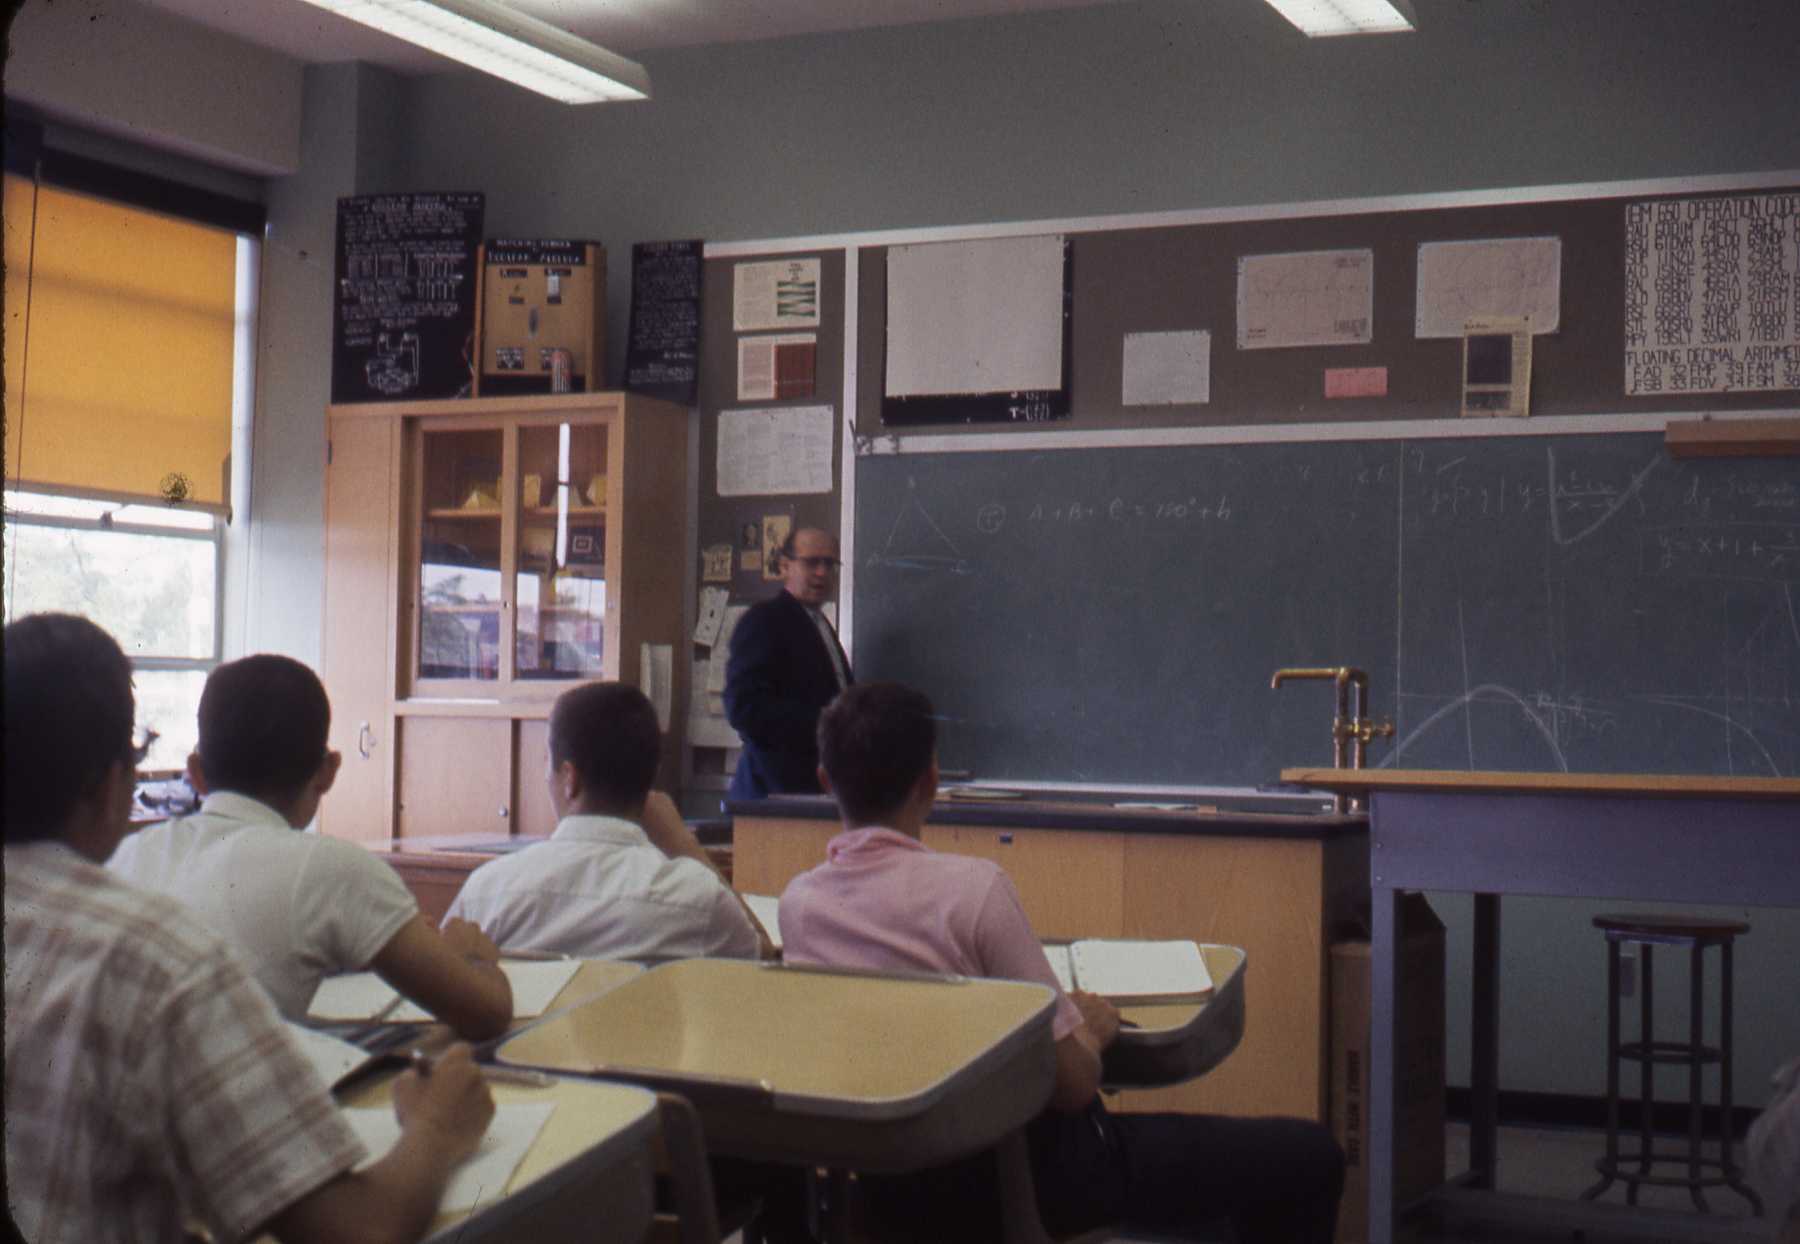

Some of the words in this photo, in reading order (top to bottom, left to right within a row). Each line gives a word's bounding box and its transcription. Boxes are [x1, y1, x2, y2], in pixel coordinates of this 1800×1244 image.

[1627, 203, 1651, 222] IBM
[1658, 201, 1679, 221] 650
[1688, 198, 1760, 219] OPERATION
[1655, 235, 1668, 250] 61
[1671, 262, 1694, 277] NZE
[1763, 272, 1790, 286] RAM
[1716, 287, 1741, 301] STU
[1627, 349, 1680, 366] FLOATING
[1687, 346, 1735, 364] DECIMAL
[1633, 365, 1661, 378] FAD
[1747, 360, 1774, 373] FAM
[1690, 375, 1716, 389] FDV
